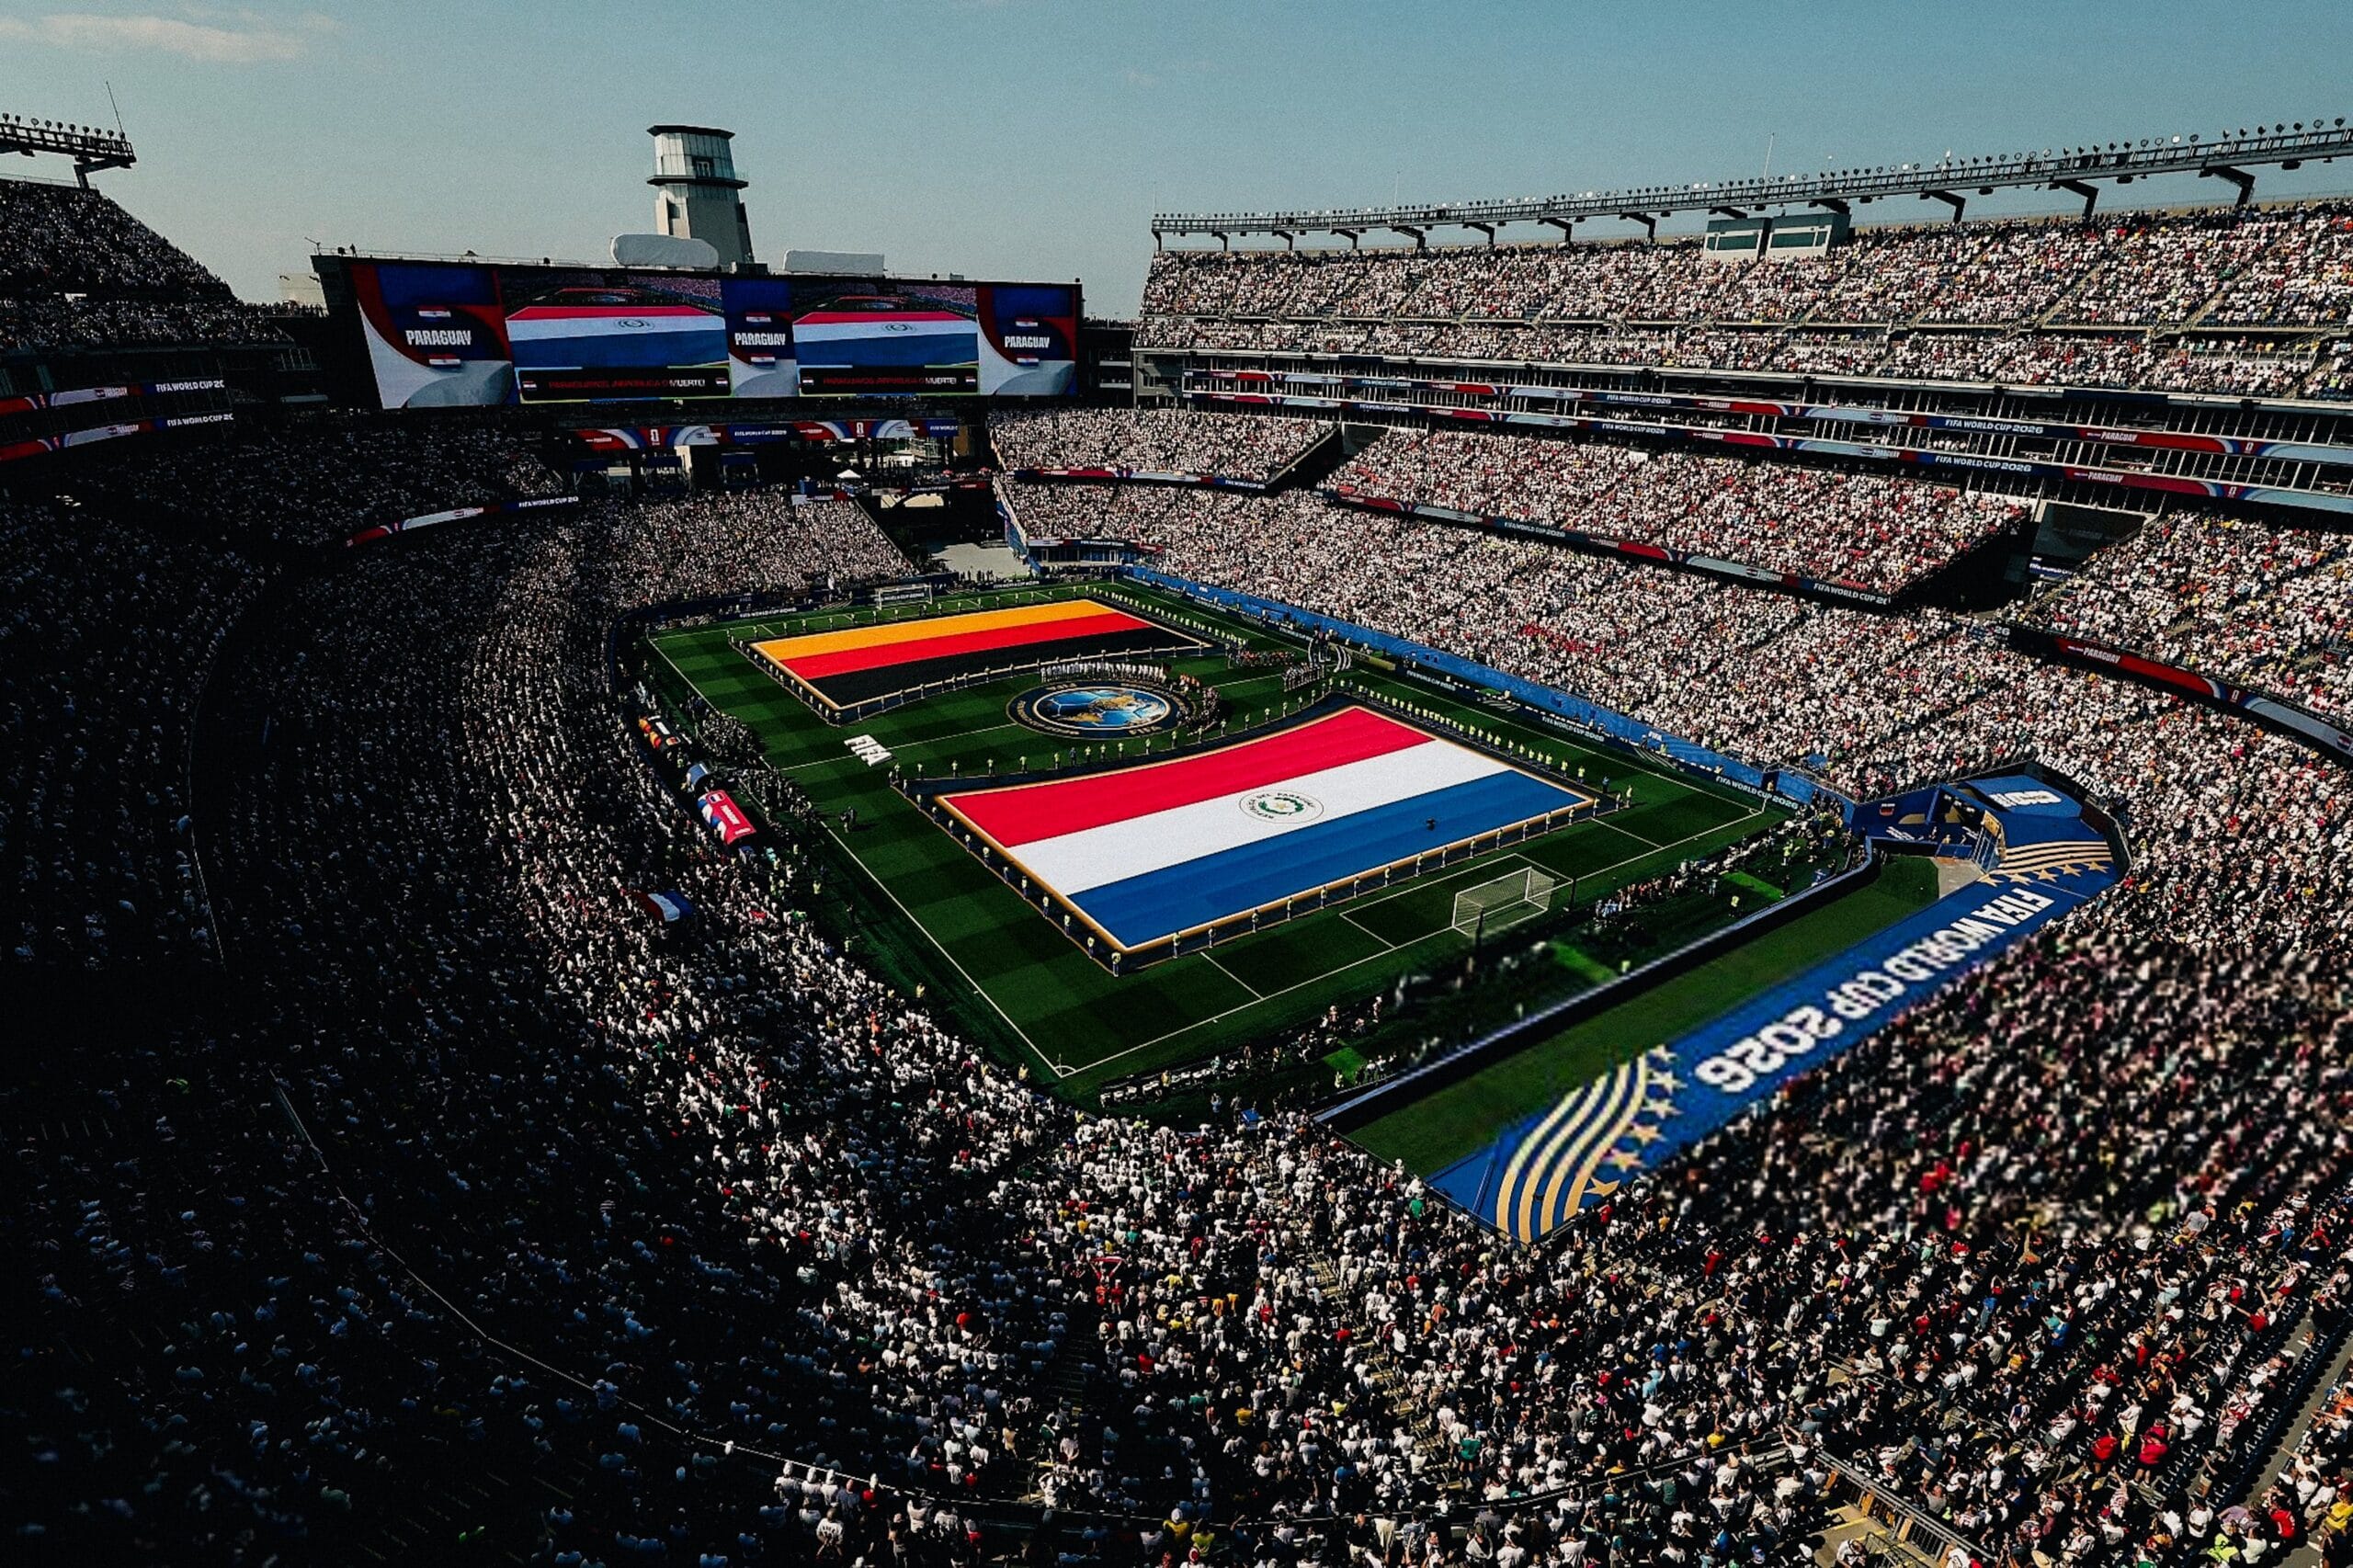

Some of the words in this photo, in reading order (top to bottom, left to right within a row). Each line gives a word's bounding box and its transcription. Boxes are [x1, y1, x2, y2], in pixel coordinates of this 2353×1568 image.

[405, 329, 472, 347] PARAGUAY
[734, 332, 786, 347] PARAGUAY
[1004, 335, 1050, 349] PARAGUAY
[1963, 420, 1994, 429] WORLD
[1994, 423, 2012, 431] CUP
[2012, 424, 2044, 434] 2026
[2100, 431, 2138, 442] PARAGUAY
[1935, 455, 1952, 463] FIFA
[1953, 457, 1983, 467] WORLD
[1984, 460, 2001, 469] CUP
[2001, 462, 2032, 472] 2026
[1813, 583, 1830, 593] FIFA
[1830, 586, 1859, 598] WORLD
[1859, 593, 1876, 602] CUP
[2084, 647, 2121, 664] PARAGUAY
[844, 734, 892, 767] FIFA
[2035, 753, 2077, 778] NEUSS
[1716, 776, 1731, 786] FIFA
[1732, 780, 1757, 795] WORLD
[1757, 790, 1772, 800] CUP
[1772, 795, 1799, 810] 2026
[1971, 888, 2055, 926] FIFA
[1883, 917, 2006, 982] WORLD
[1825, 971, 1906, 1020] CUP
[1695, 1005, 1844, 1094] 2026
